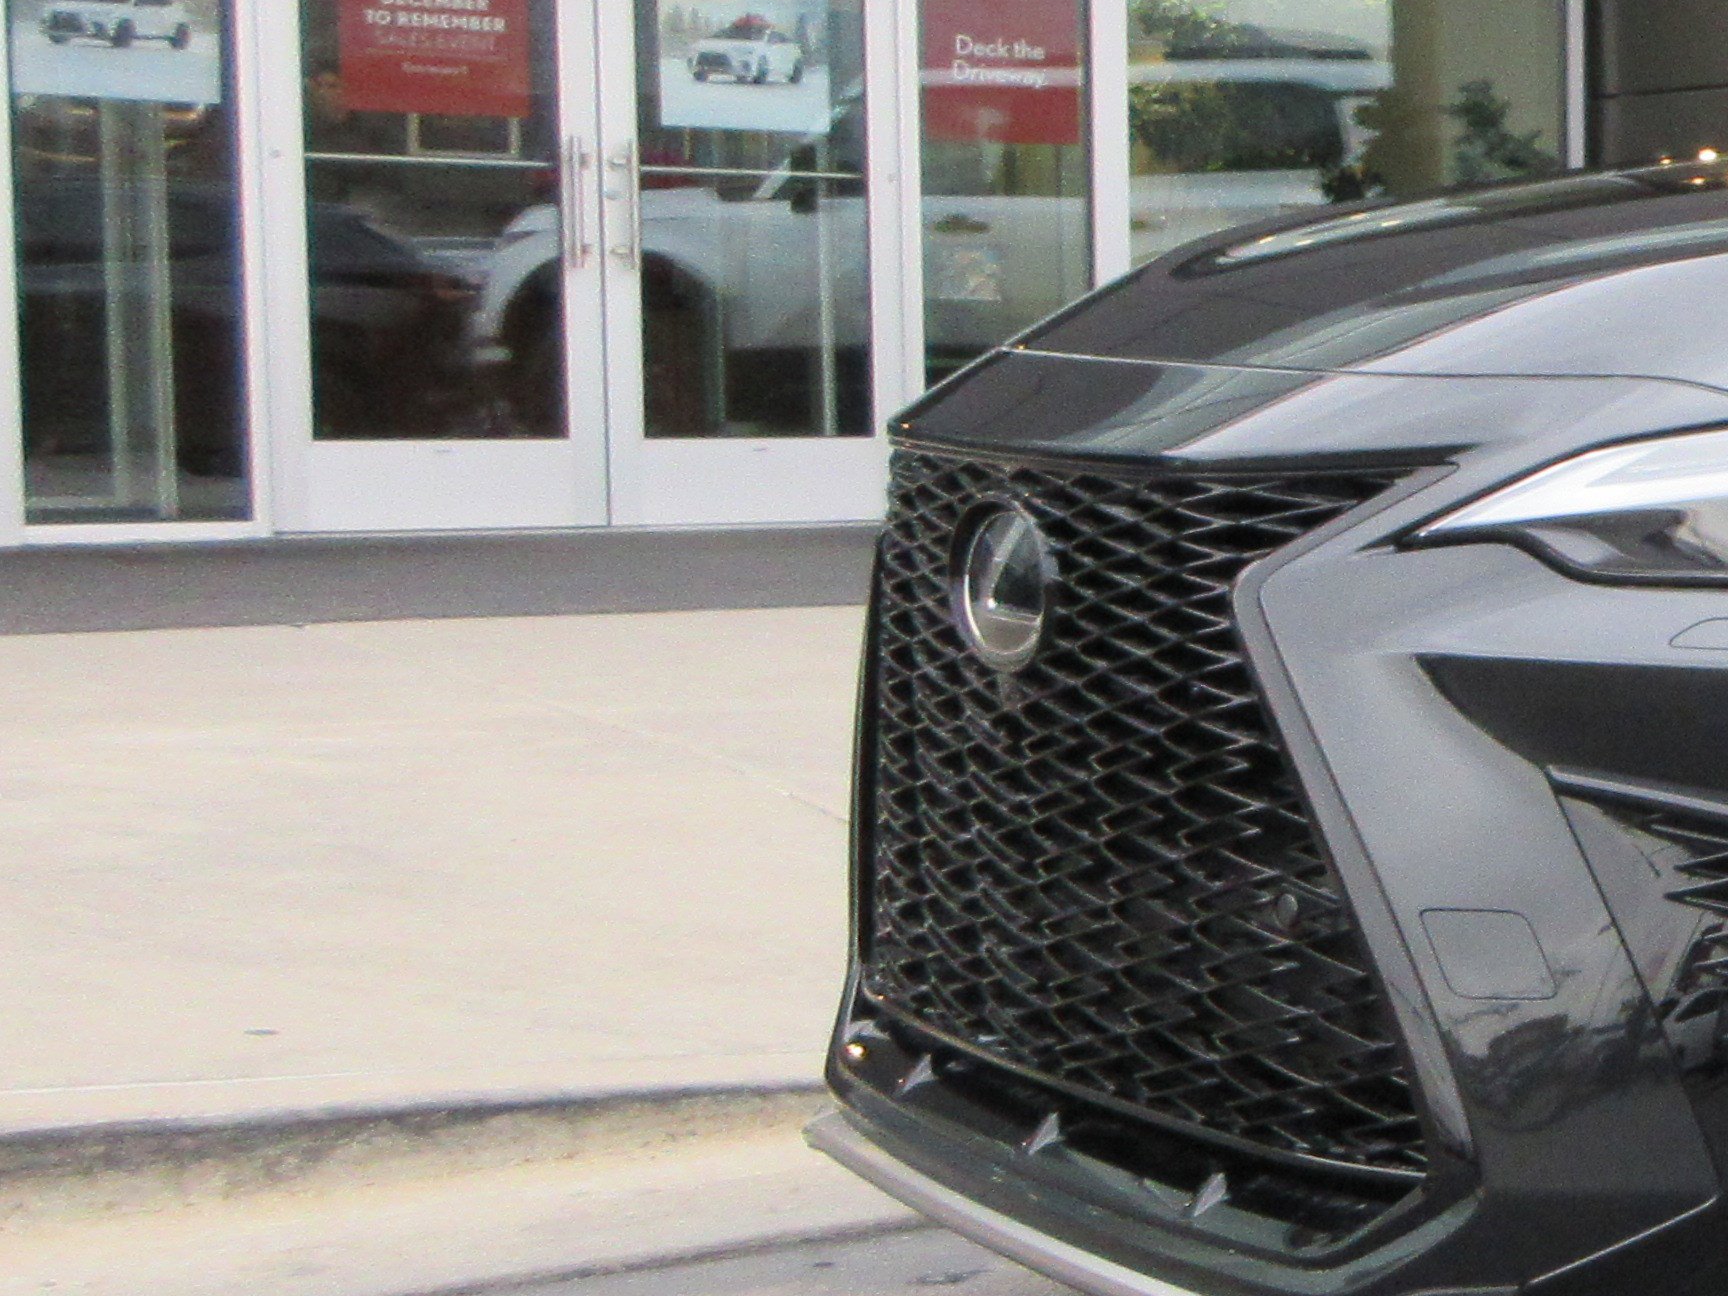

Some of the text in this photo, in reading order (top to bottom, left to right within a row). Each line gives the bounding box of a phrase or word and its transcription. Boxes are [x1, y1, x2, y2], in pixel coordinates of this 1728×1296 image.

[363, 8, 507, 32] TO REMEMBER
[955, 33, 1046, 59] Deck the
